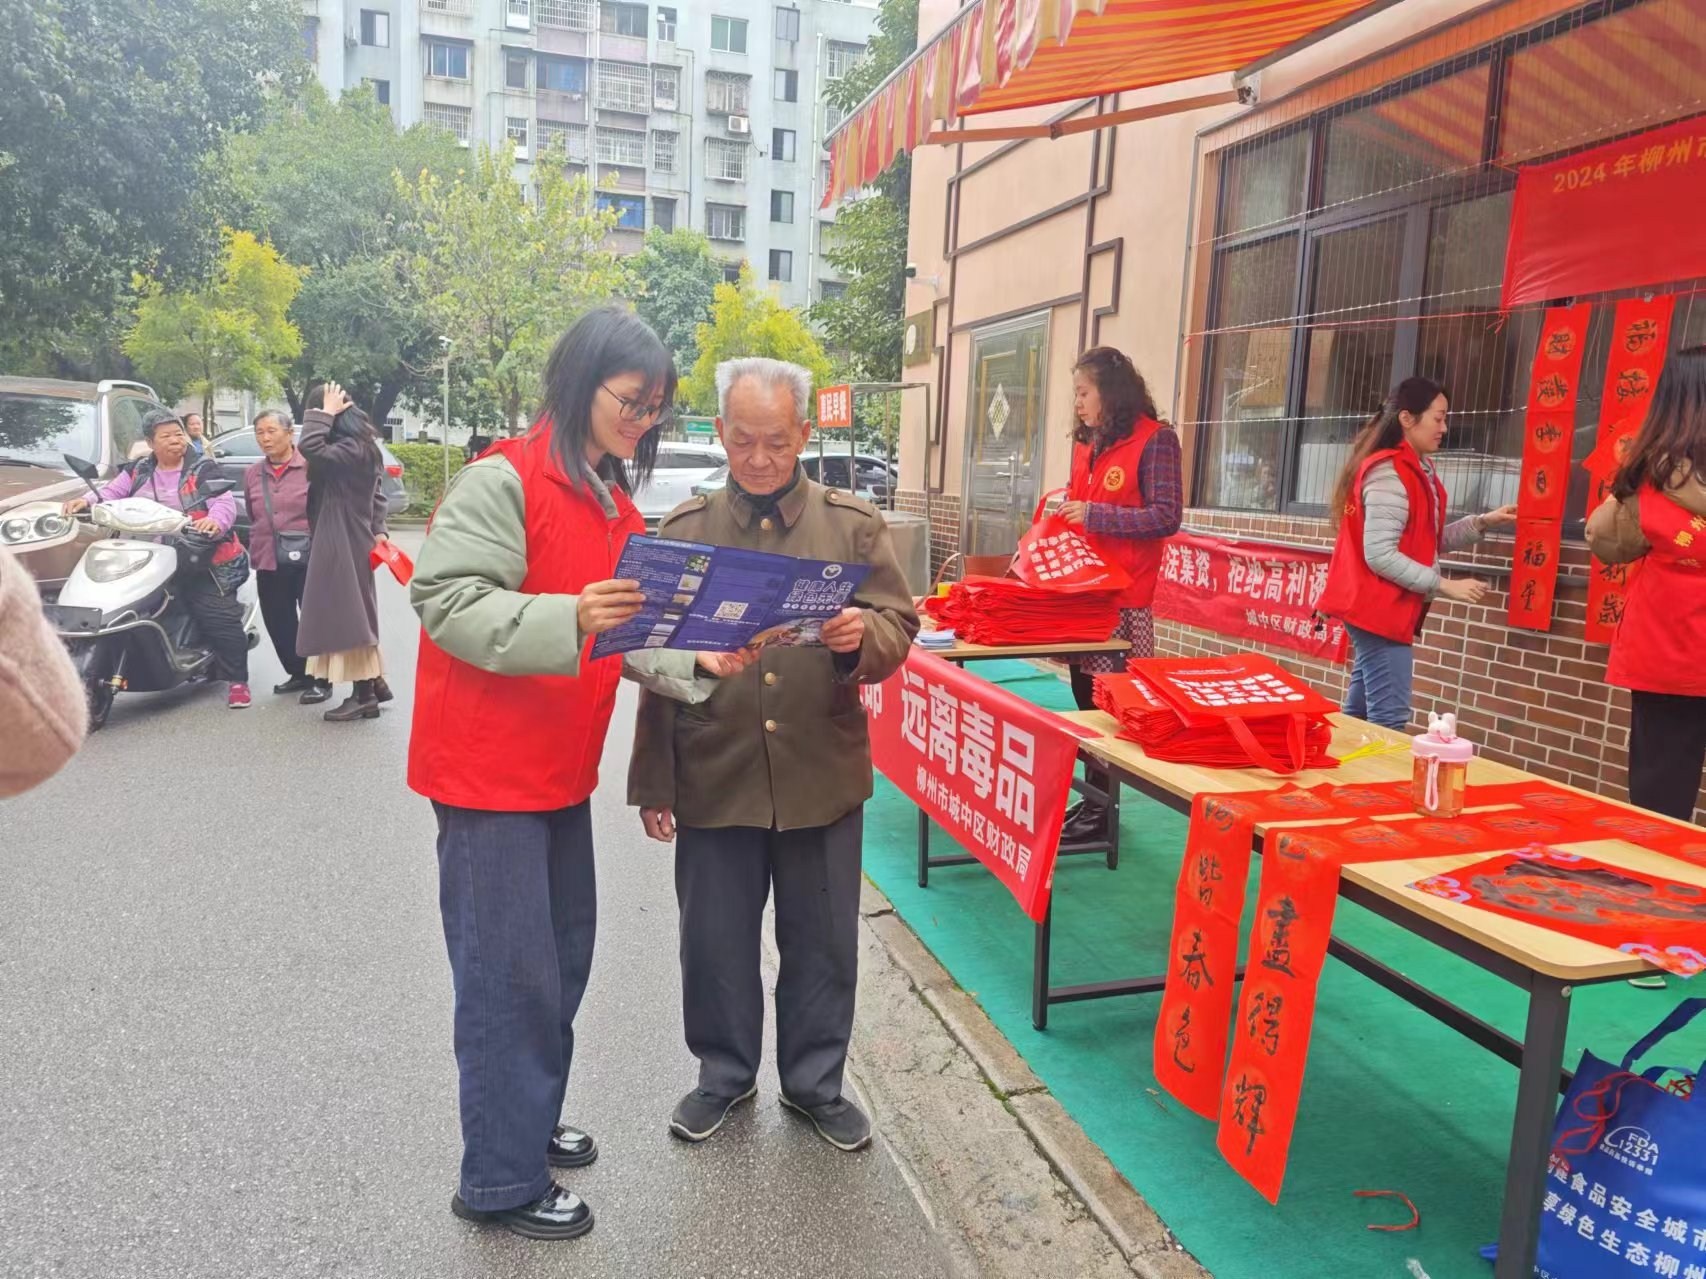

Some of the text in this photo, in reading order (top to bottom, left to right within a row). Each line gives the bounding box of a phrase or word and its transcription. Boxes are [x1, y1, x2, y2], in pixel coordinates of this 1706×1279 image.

[1160, 544, 1329, 608] 法集资，拒绝高利诱
[901, 664, 1036, 834] 远离毒品
[915, 764, 1033, 882] 柳州市城中区财政局
[1619, 1139, 1659, 1166] 12331
[1628, 1132, 1659, 1154] FDA
